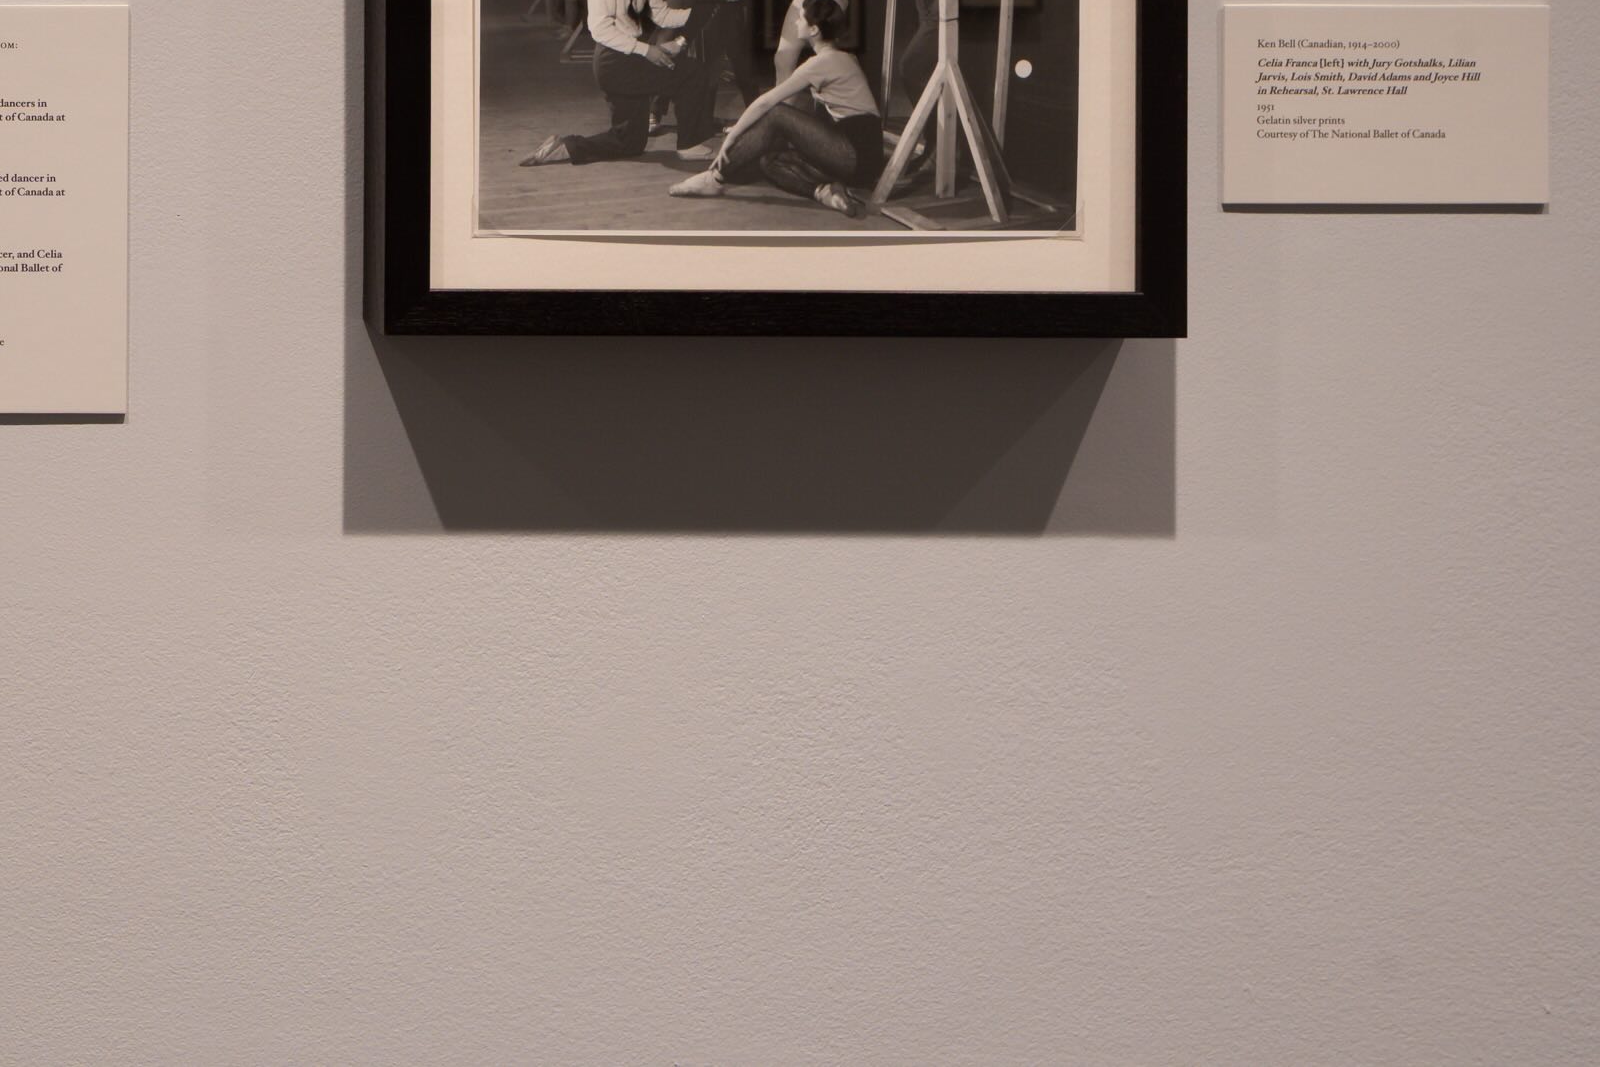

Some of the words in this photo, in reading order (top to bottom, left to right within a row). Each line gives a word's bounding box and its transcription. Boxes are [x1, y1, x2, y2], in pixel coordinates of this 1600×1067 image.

[1257, 38, 1277, 49] Ken
[1278, 38, 1296, 49] Bell
[1297, 38, 1346, 50] (Canadian,
[1257, 57, 1284, 68] Celia
[1284, 58, 1319, 68] Franca
[1319, 57, 1345, 69] [left]
[1347, 58, 1370, 68] with
[1368, 58, 1394, 71] Jury
[1393, 57, 1446, 69] Gotshalks,
[1447, 58, 1477, 68] Lilian
[1254, 71, 1289, 84] Jarvis,
[1290, 71, 1312, 82] Lois
[1313, 71, 1346, 83] Smith,
[1347, 71, 1379, 82] David
[1377, 71, 1412, 82] Adams
[1412, 72, 1432, 82] and
[1430, 71, 1460, 84] Joyce
[1460, 71, 1481, 82] Hill
[1256, 85, 1268, 95] in
[1269, 85, 1320, 97] Rehearsal,
[1321, 85, 1335, 95] St.
[1336, 85, 1385, 96] Lawrence
[1386, 85, 1409, 96] Hall
[37, 98, 48, 108] in
[1257, 104, 1275, 113] 1951
[4, 111, 18, 122] of
[16, 112, 55, 122] Canada
[55, 114, 66, 122] at
[1256, 115, 1291, 125] Gelatin
[1292, 115, 1317, 125] silver
[1318, 117, 1346, 128] prints
[1256, 129, 1299, 141] Courtesy
[1299, 128, 1311, 139] of
[1309, 129, 1330, 139] The
[1331, 128, 1371, 139] National
[1372, 129, 1399, 139] Ballet
[1400, 128, 1412, 139] of
[1411, 128, 1446, 139] Canada
[10, 173, 45, 183] dancer
[46, 173, 57, 183] in
[4, 186, 17, 197] of
[16, 186, 54, 197] Canada
[55, 189, 66, 197] at
[16, 249, 35, 259] and
[36, 249, 63, 259] Celia
[20, 262, 51, 273] Ballet
[51, 262, 64, 273] of
